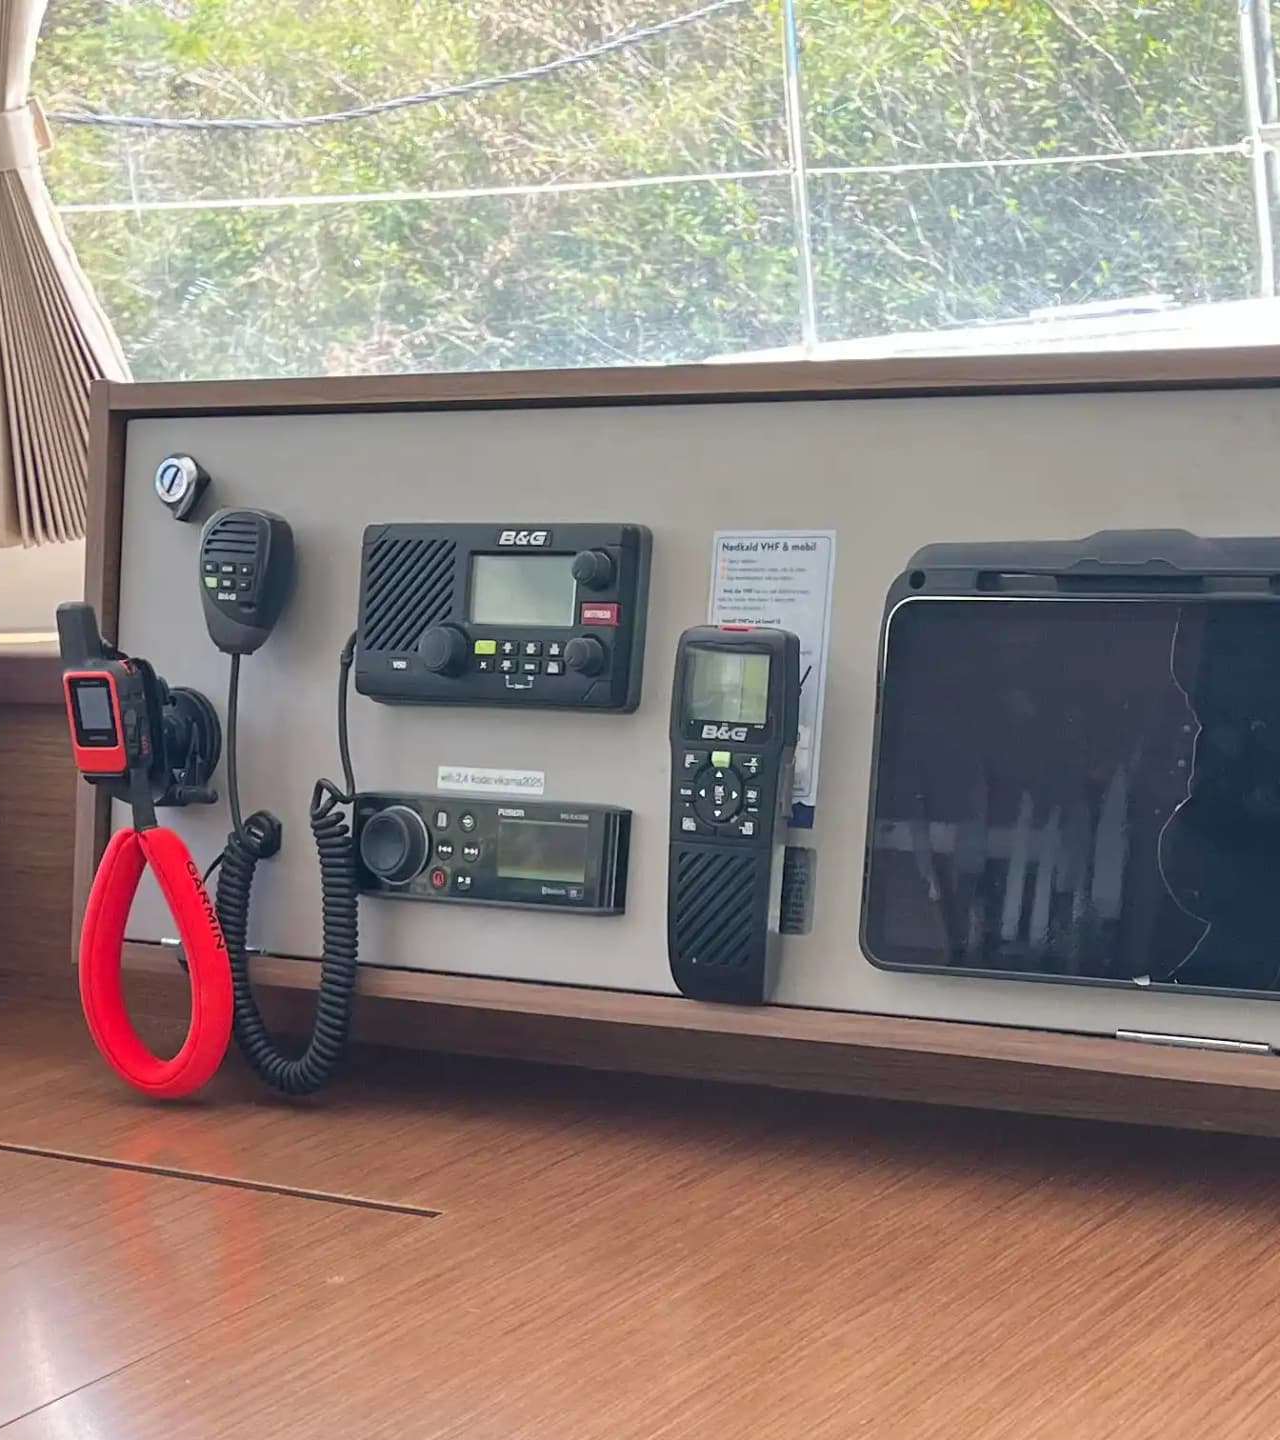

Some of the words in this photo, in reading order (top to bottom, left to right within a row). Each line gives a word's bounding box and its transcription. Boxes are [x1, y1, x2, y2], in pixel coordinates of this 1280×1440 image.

[498, 530, 548, 545] B&G
[761, 542, 780, 551] VHF
[791, 541, 817, 551] mobil
[701, 724, 749, 742] B&G
[186, 860, 225, 949] GARMIN
